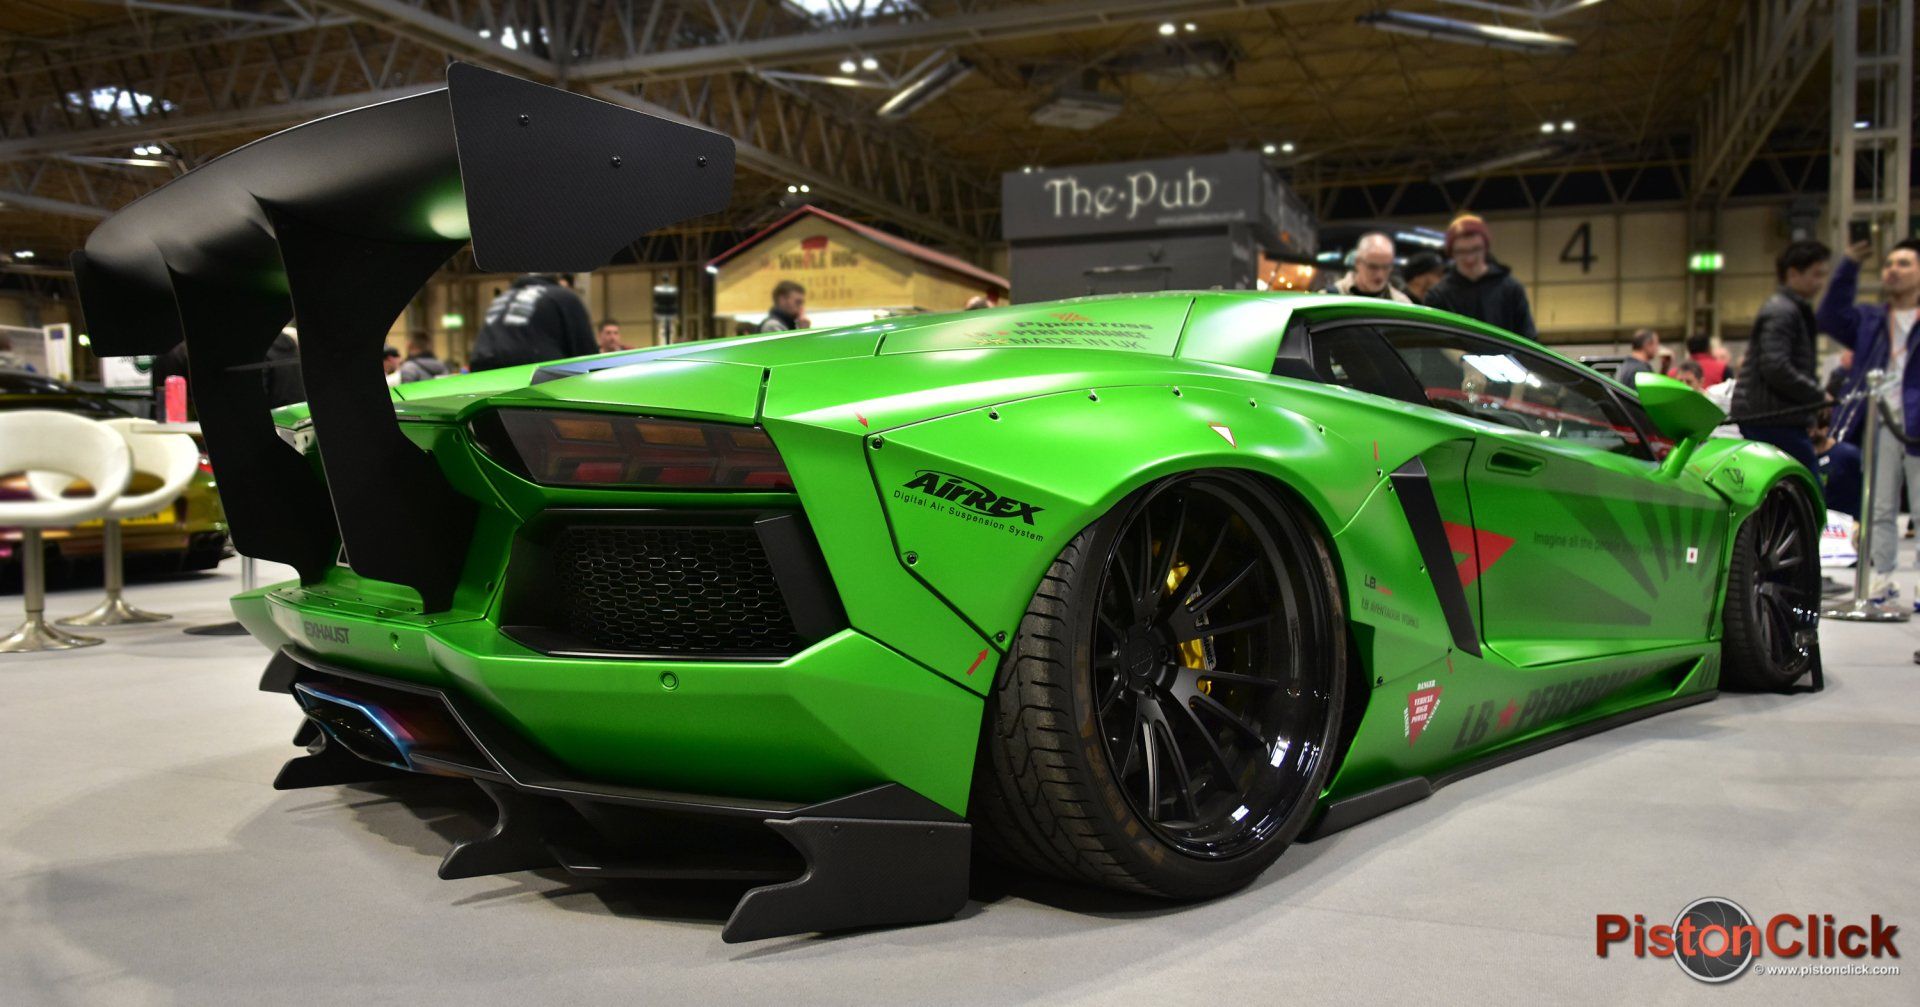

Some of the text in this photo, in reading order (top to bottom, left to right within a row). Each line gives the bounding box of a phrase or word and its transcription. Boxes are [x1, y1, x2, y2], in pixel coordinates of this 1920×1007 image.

[1558, 221, 1599, 275] 4
[893, 490, 1045, 543] Digital Air Suspension System
[1364, 574, 1377, 590] LB
[304, 621, 350, 645] EXHAUST
